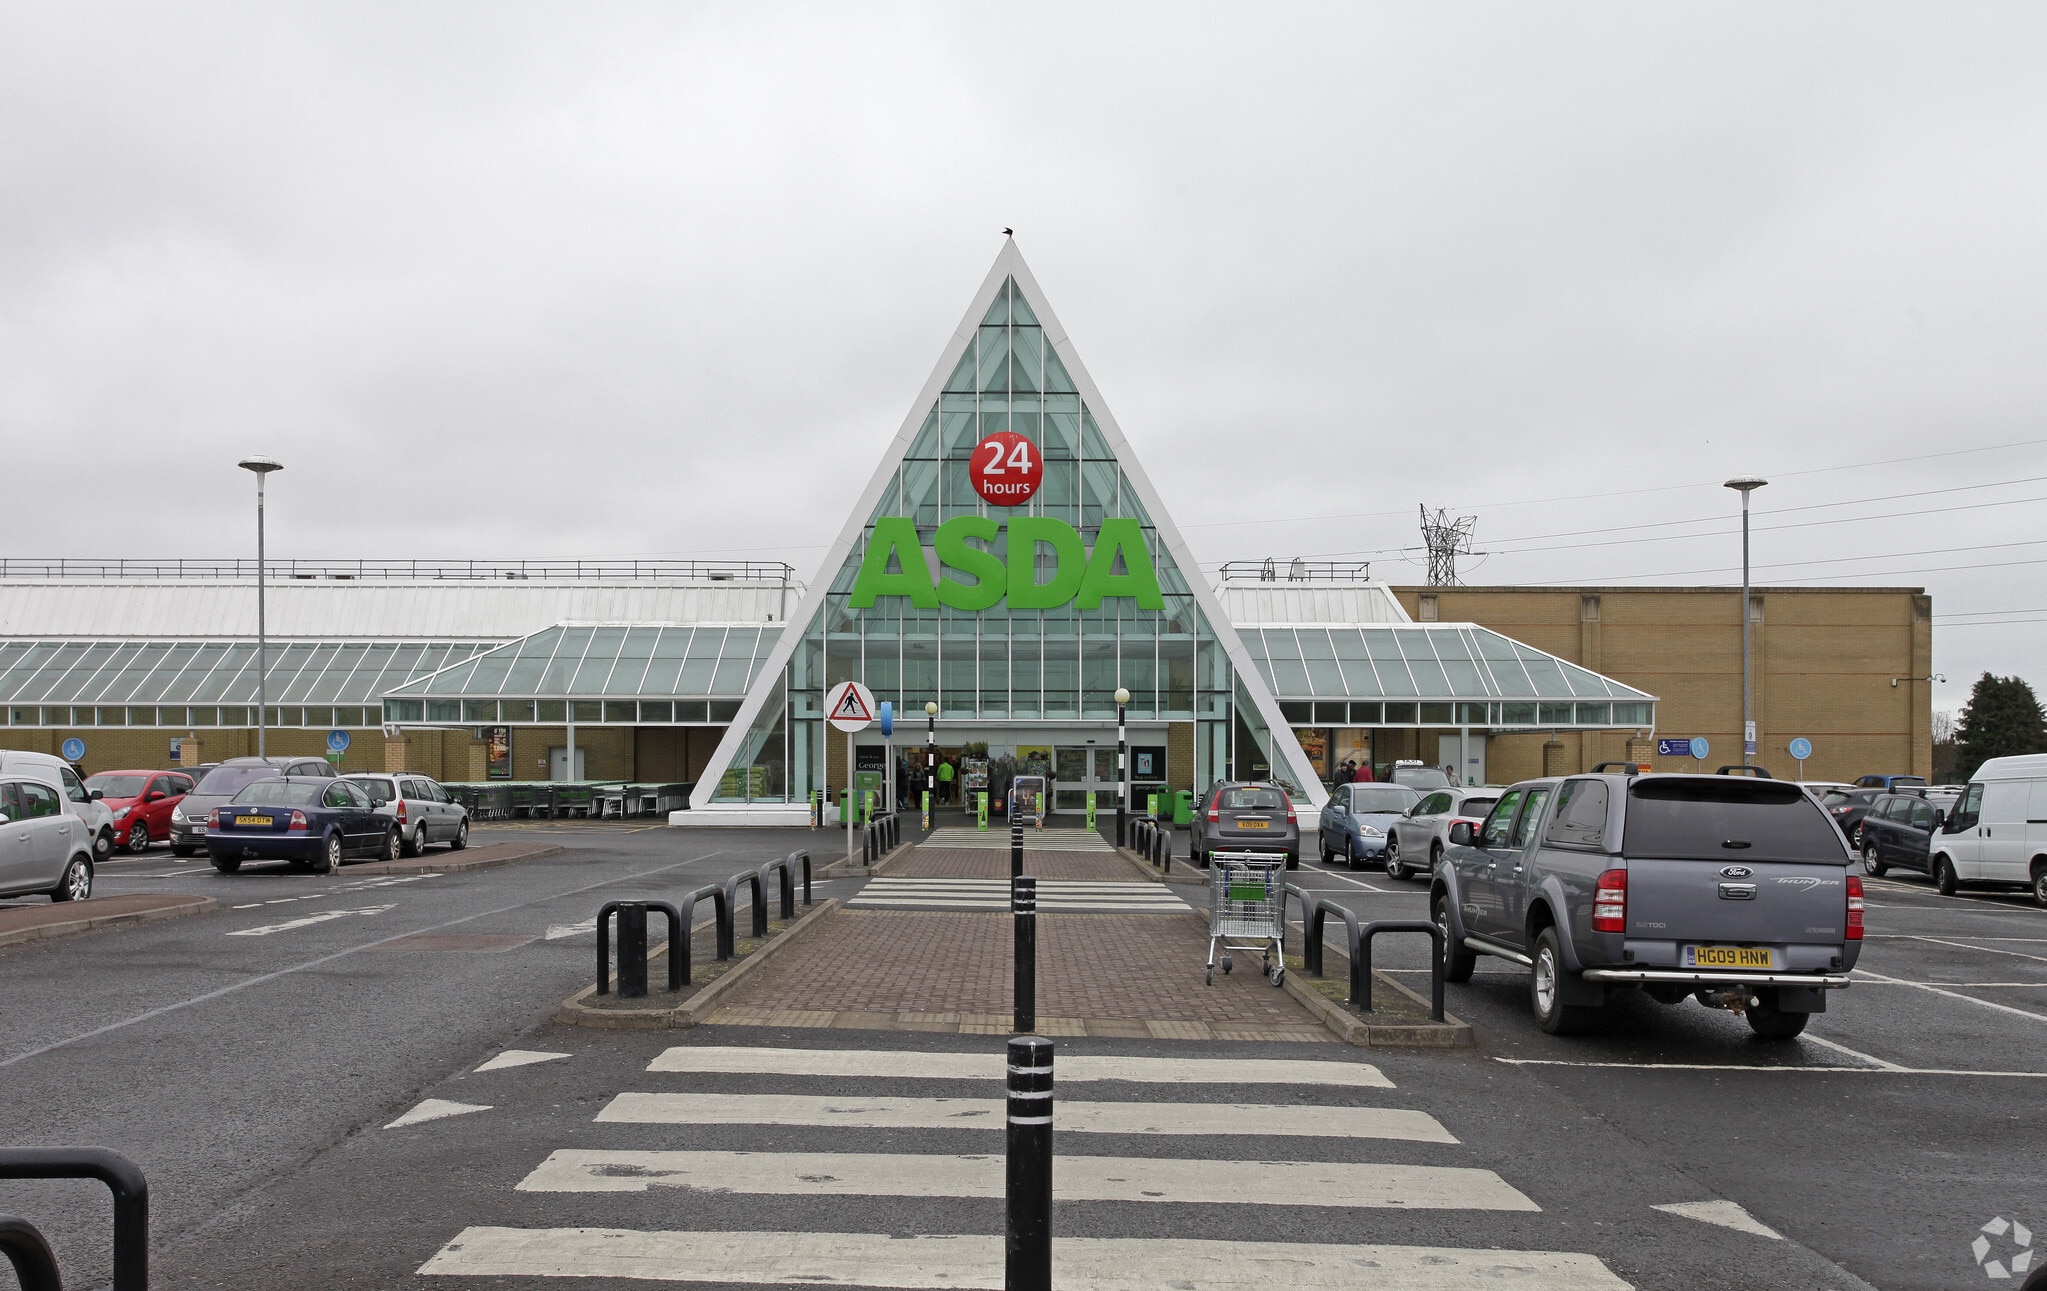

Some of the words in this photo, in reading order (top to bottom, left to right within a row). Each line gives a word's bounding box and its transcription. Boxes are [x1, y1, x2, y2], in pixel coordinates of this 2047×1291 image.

[983, 441, 1033, 475] 24
[983, 479, 1031, 494] hours
[848, 515, 1166, 611] ASDA
[858, 762, 886, 770] George
[1728, 867, 1746, 876] Ford
[1769, 876, 1840, 892] THUNDER
[1697, 949, 1736, 964] HG09
[1739, 950, 1769, 965] HNW
